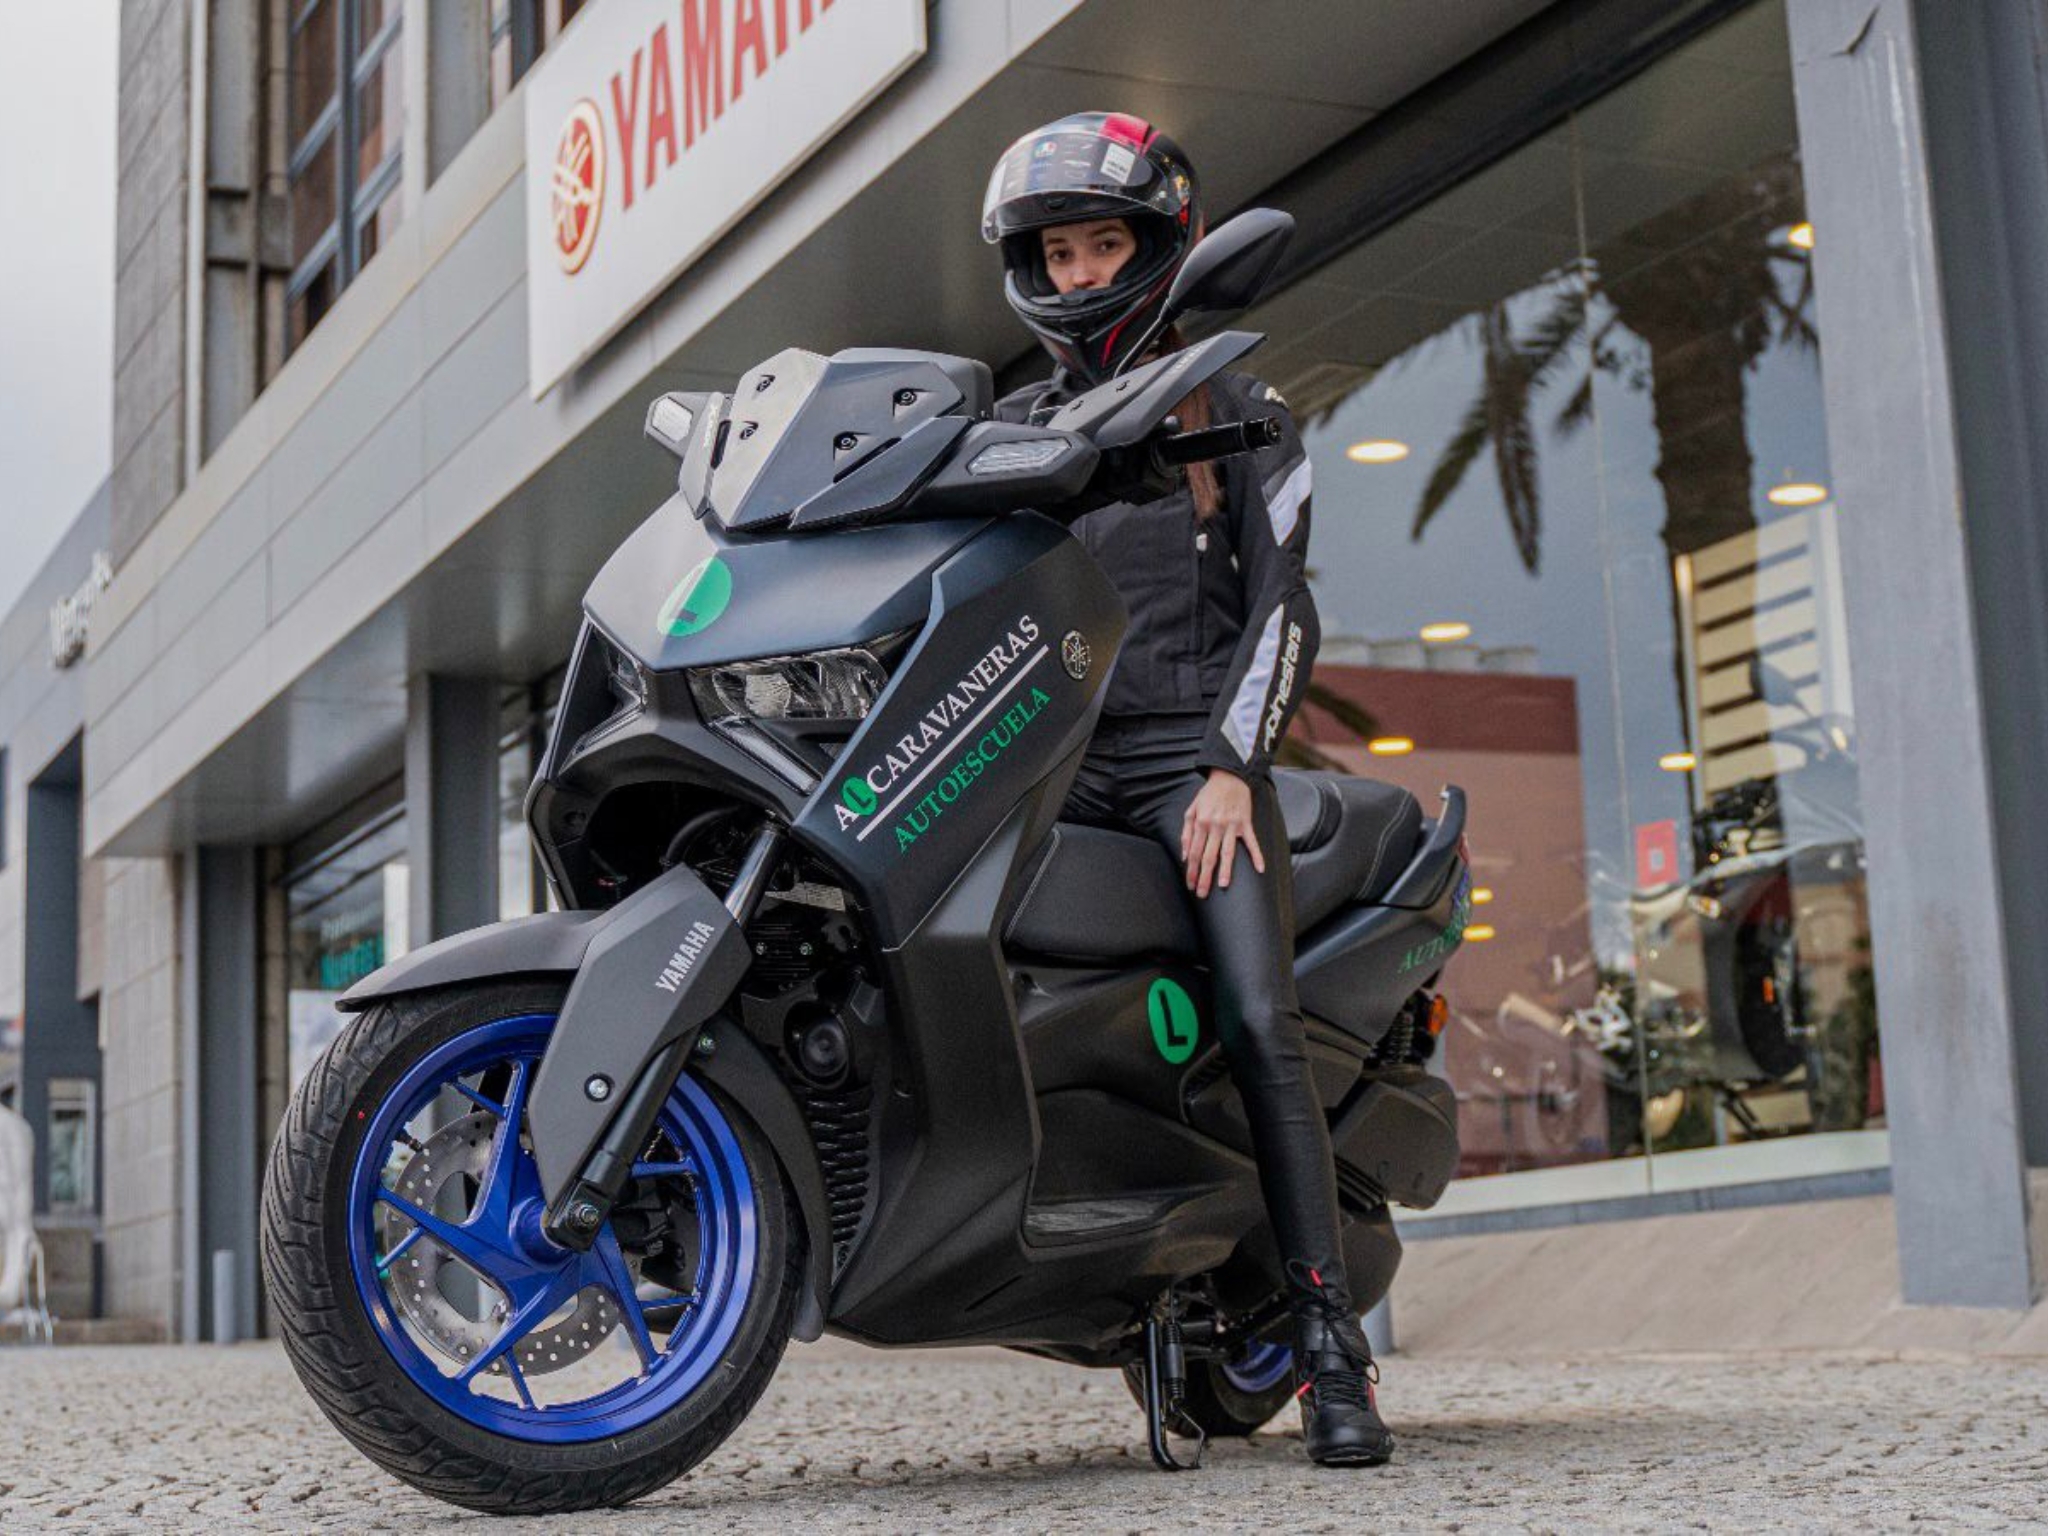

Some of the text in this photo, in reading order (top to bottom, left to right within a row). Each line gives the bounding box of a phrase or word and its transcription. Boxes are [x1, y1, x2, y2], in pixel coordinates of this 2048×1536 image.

[610, 0, 835, 212] YAMA
[834, 614, 1039, 831] ALCARAVANERAS
[895, 686, 1052, 853] AUTOESCUELA
[655, 921, 715, 993] YAMAHA
[1158, 989, 1189, 1047] L
